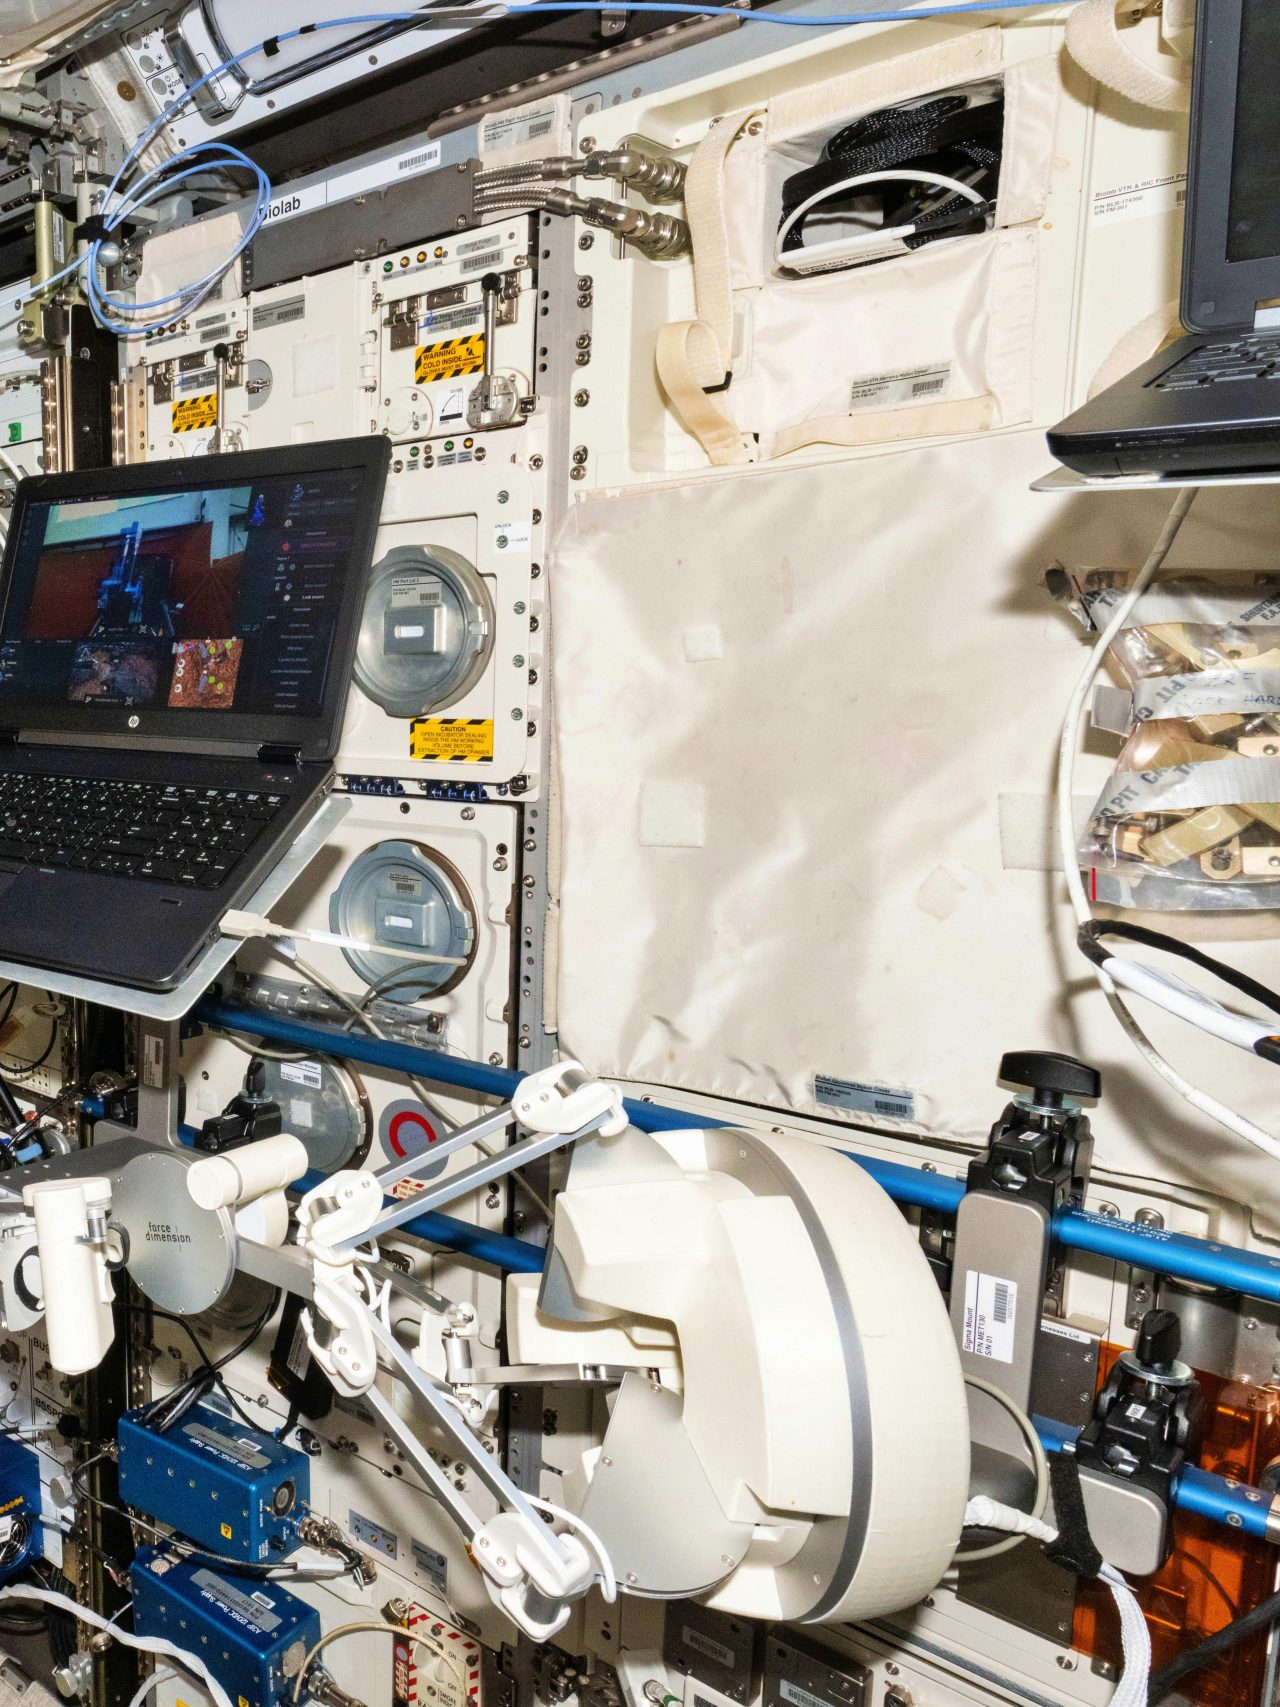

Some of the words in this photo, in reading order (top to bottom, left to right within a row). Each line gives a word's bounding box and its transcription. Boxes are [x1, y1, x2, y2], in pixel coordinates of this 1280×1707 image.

[1096, 189, 1116, 198] Biolab
[1156, 176, 1174, 184] Front
[441, 312, 453, 320] Temp
[424, 348, 456, 360] WARNING
[423, 360, 440, 370] COLD
[442, 356, 462, 366] INSIDE
[422, 368, 441, 376] GLOVES
[178, 404, 201, 414] WARNING
[178, 412, 191, 421] COLD
[1112, 786, 1140, 811] PIT
[149, 1222, 170, 1232] force
[146, 1231, 191, 1243] dimension
[986, 1336, 992, 1344] 01
[204, 1445, 220, 1455] Power
[200, 1589, 216, 1602] Supply
[215, 1601, 230, 1613] Power
[448, 1651, 457, 1660] ON
[448, 1682, 457, 1691] OFF
[440, 1691, 456, 1705] SMOKE
